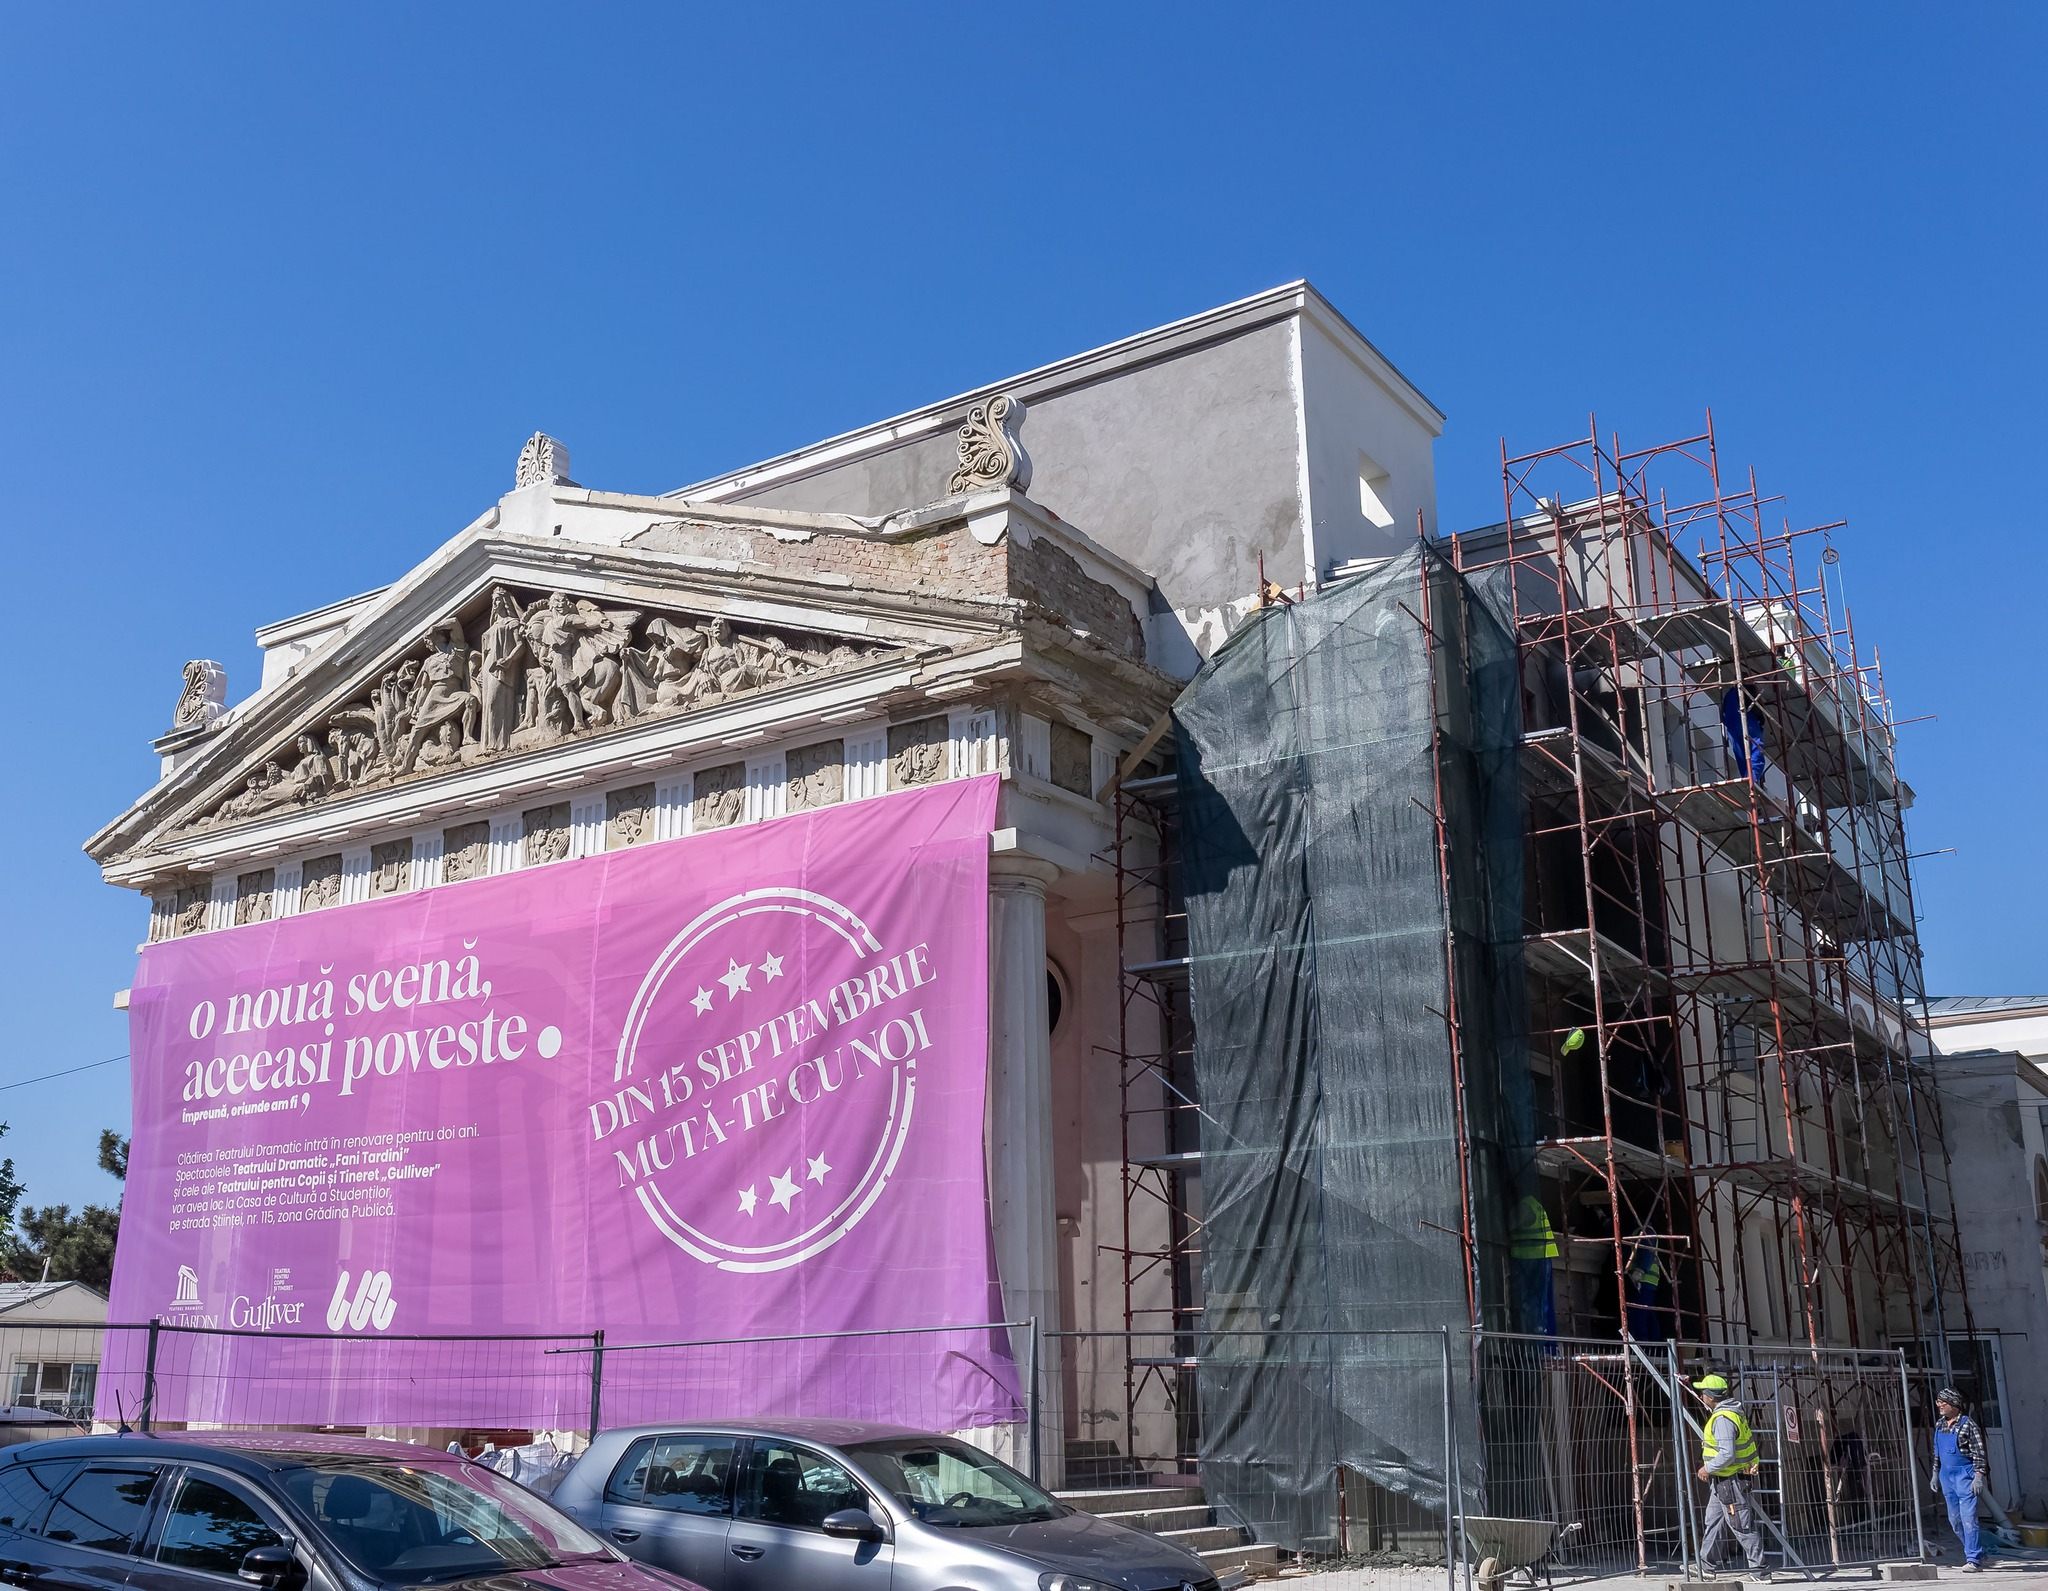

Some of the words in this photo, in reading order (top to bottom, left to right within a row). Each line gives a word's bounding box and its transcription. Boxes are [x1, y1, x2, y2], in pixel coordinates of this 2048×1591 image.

[189, 1000, 216, 1040] o
[222, 962, 335, 1035] nouă
[345, 936, 492, 1016] scenă,
[588, 1079, 656, 1142] DIN
[660, 1062, 694, 1108] 15
[696, 942, 938, 1091] SEPTEMBRIE
[182, 1104, 229, 1125] Împreună,
[231, 1100, 270, 1117] oriunde
[271, 1098, 289, 1112] am
[290, 1094, 299, 1109] fi
[612, 1077, 785, 1190] MUTĂ-TE
[787, 1048, 845, 1105] CU
[845, 1008, 934, 1080] NOI
[177, 1152, 213, 1166] Clădirea
[215, 1144, 255, 1161] Teatrului
[256, 1140, 302, 1157] Dramatic
[304, 1137, 328, 1153] intră
[330, 1137, 341, 1149] în
[343, 1133, 394, 1148] renovare
[395, 1129, 434, 1148] pentru
[437, 1125, 456, 1140] doi
[458, 1123, 480, 1139] ani.
[175, 1165, 231, 1185] Spectacolele
[232, 1158, 277, 1175] Teatrului
[278, 1154, 328, 1172] Dramatic
[329, 1151, 360, 1169] „Fani
[181, 1184, 200, 1198] cele
[201, 1183, 215, 1196] ale
[217, 1177, 260, 1194] Teatrului
[261, 1176, 296, 1194] pentru
[297, 1171, 326, 1190] Copii
[327, 1170, 338, 1188] și
[339, 1168, 380, 1184] Tineret
[169, 1220, 181, 1234] pe
[181, 1216, 210, 1230] strada
[246, 1213, 259, 1225] nr.
[261, 1210, 275, 1225] 115,
[277, 1211, 302, 1223] zona
[304, 1206, 349, 1221] Grădina
[351, 1202, 396, 1218] Publică.
[172, 1203, 186, 1215] vor
[186, 1202, 208, 1213] avea
[210, 1198, 224, 1211] loc
[225, 1197, 234, 1210] la
[236, 1195, 262, 1209] Casa
[263, 1193, 277, 1206] de
[279, 1189, 318, 1206] Cultură
[319, 1191, 327, 1203] a
[229, 1295, 305, 1333] Gulliver
